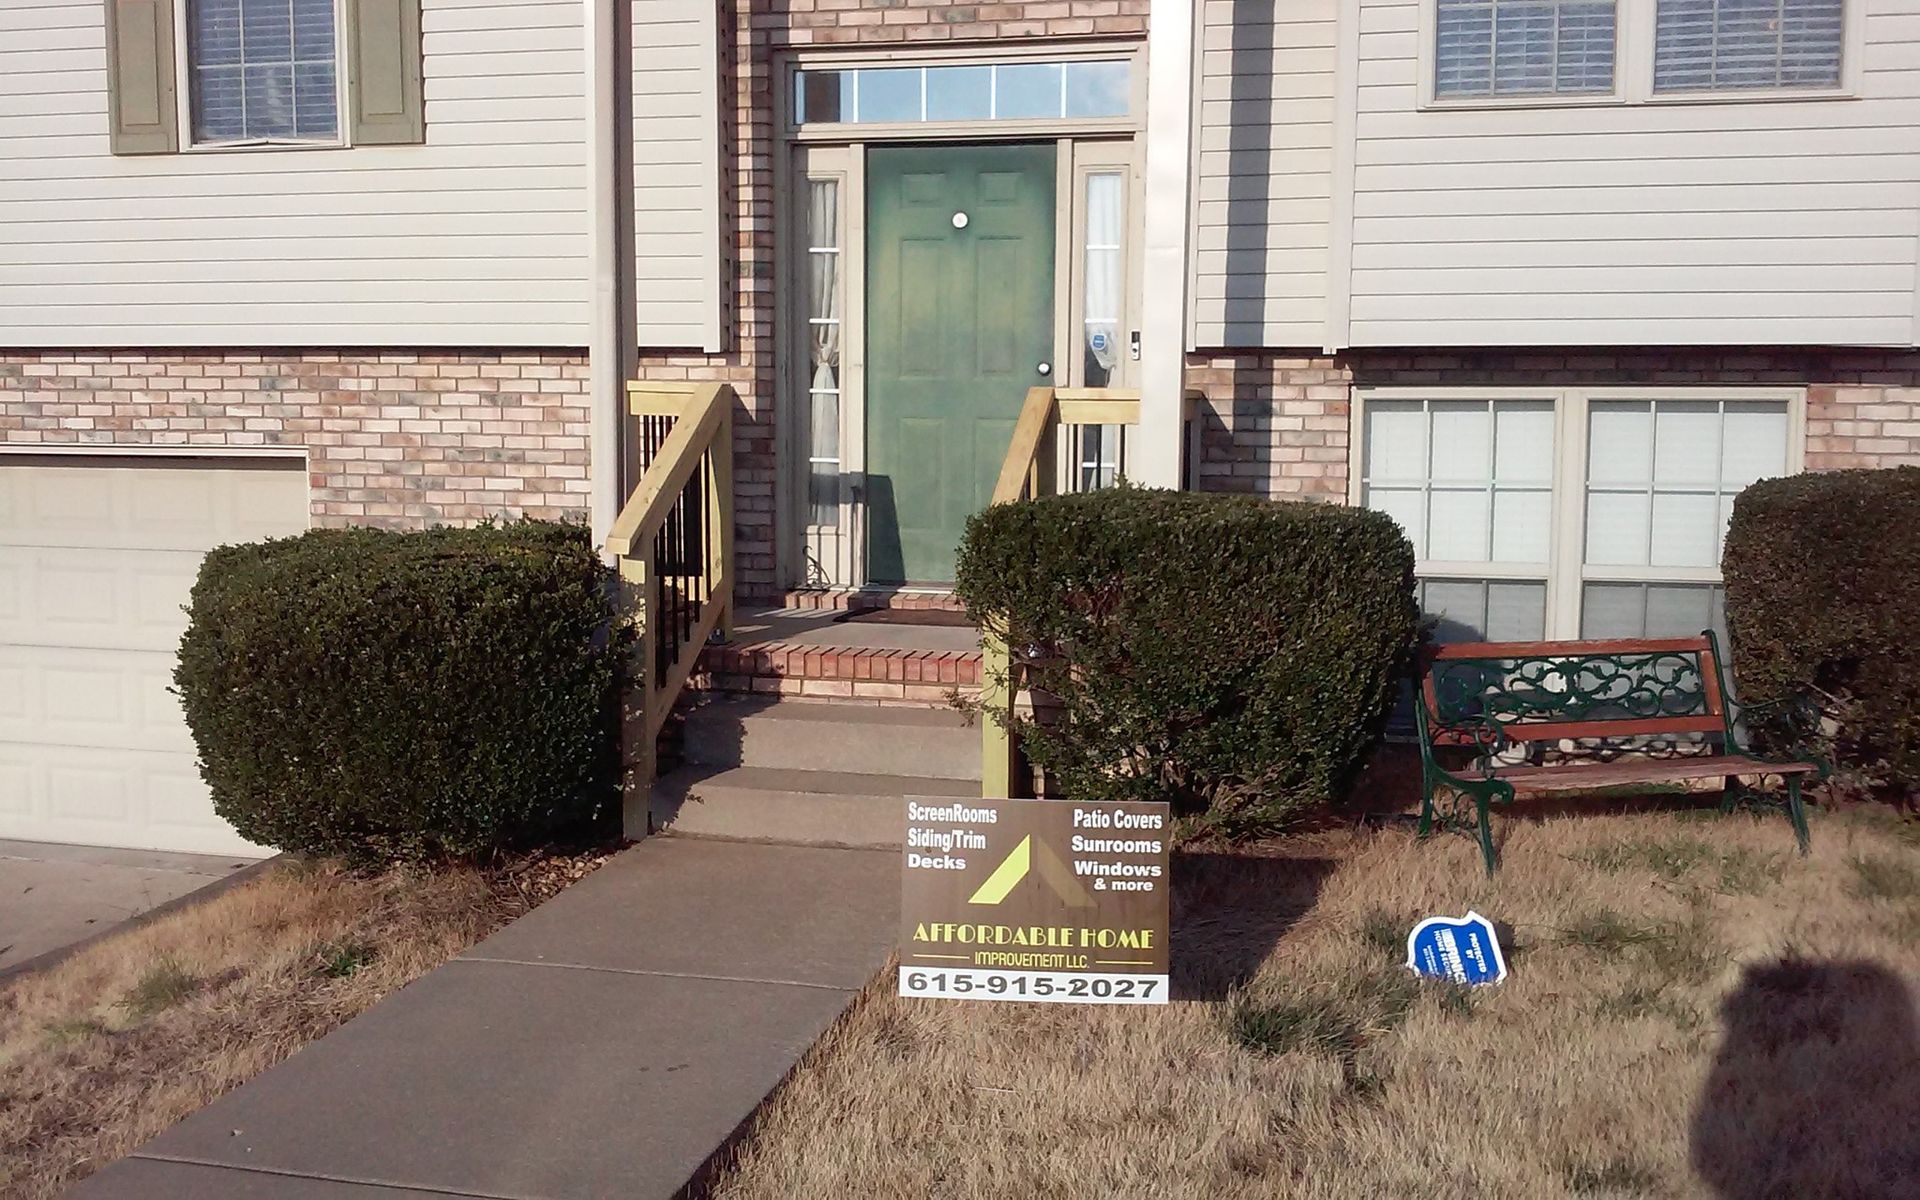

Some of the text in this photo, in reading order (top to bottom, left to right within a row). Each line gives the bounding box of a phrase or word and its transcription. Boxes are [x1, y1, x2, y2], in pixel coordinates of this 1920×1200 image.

[908, 802, 998, 824] ScreenRooms
[1073, 808, 1163, 830] Patio Covers
[908, 827, 986, 853] Siding/Trim
[1071, 835, 1162, 854] Sunrooms
[908, 853, 967, 870] Decks
[1074, 860, 1162, 877] Windows
[1094, 877, 1154, 892] & more
[913, 922, 1154, 949] AFFORDABLE HOME
[1433, 930, 1446, 952] HOME
[974, 951, 1064, 968] IMPROVEMENT
[1465, 949, 1475, 959] BY
[1469, 932, 1487, 973] PROTECTED
[907, 972, 1159, 998] 615-915-2027
